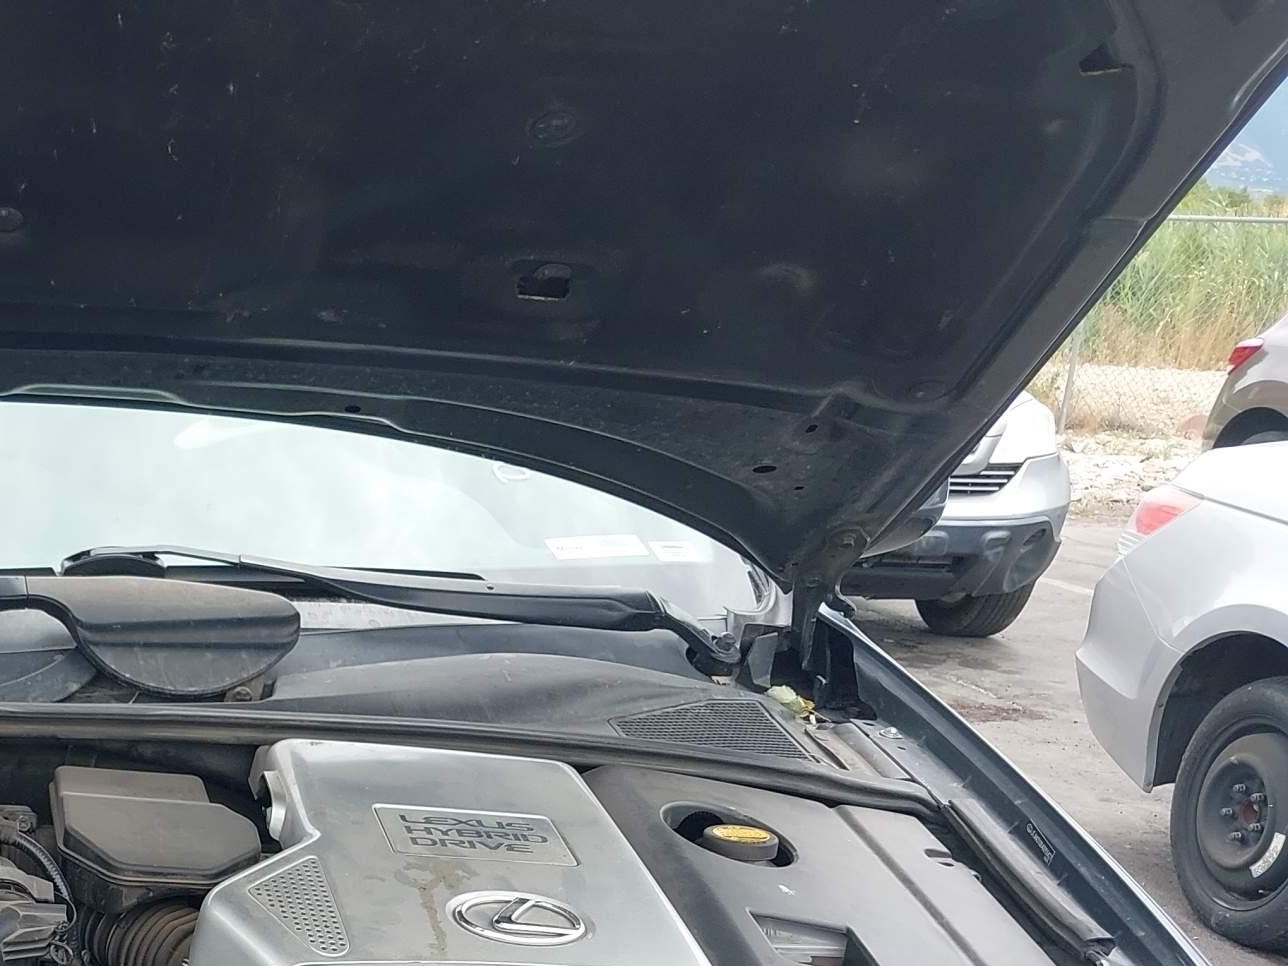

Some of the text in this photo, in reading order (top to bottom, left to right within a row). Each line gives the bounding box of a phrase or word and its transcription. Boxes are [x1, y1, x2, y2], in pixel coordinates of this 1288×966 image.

[399, 814, 534, 831] LEXUS
[404, 825, 549, 844] HYBRID
[409, 836, 534, 853] DRIVE
